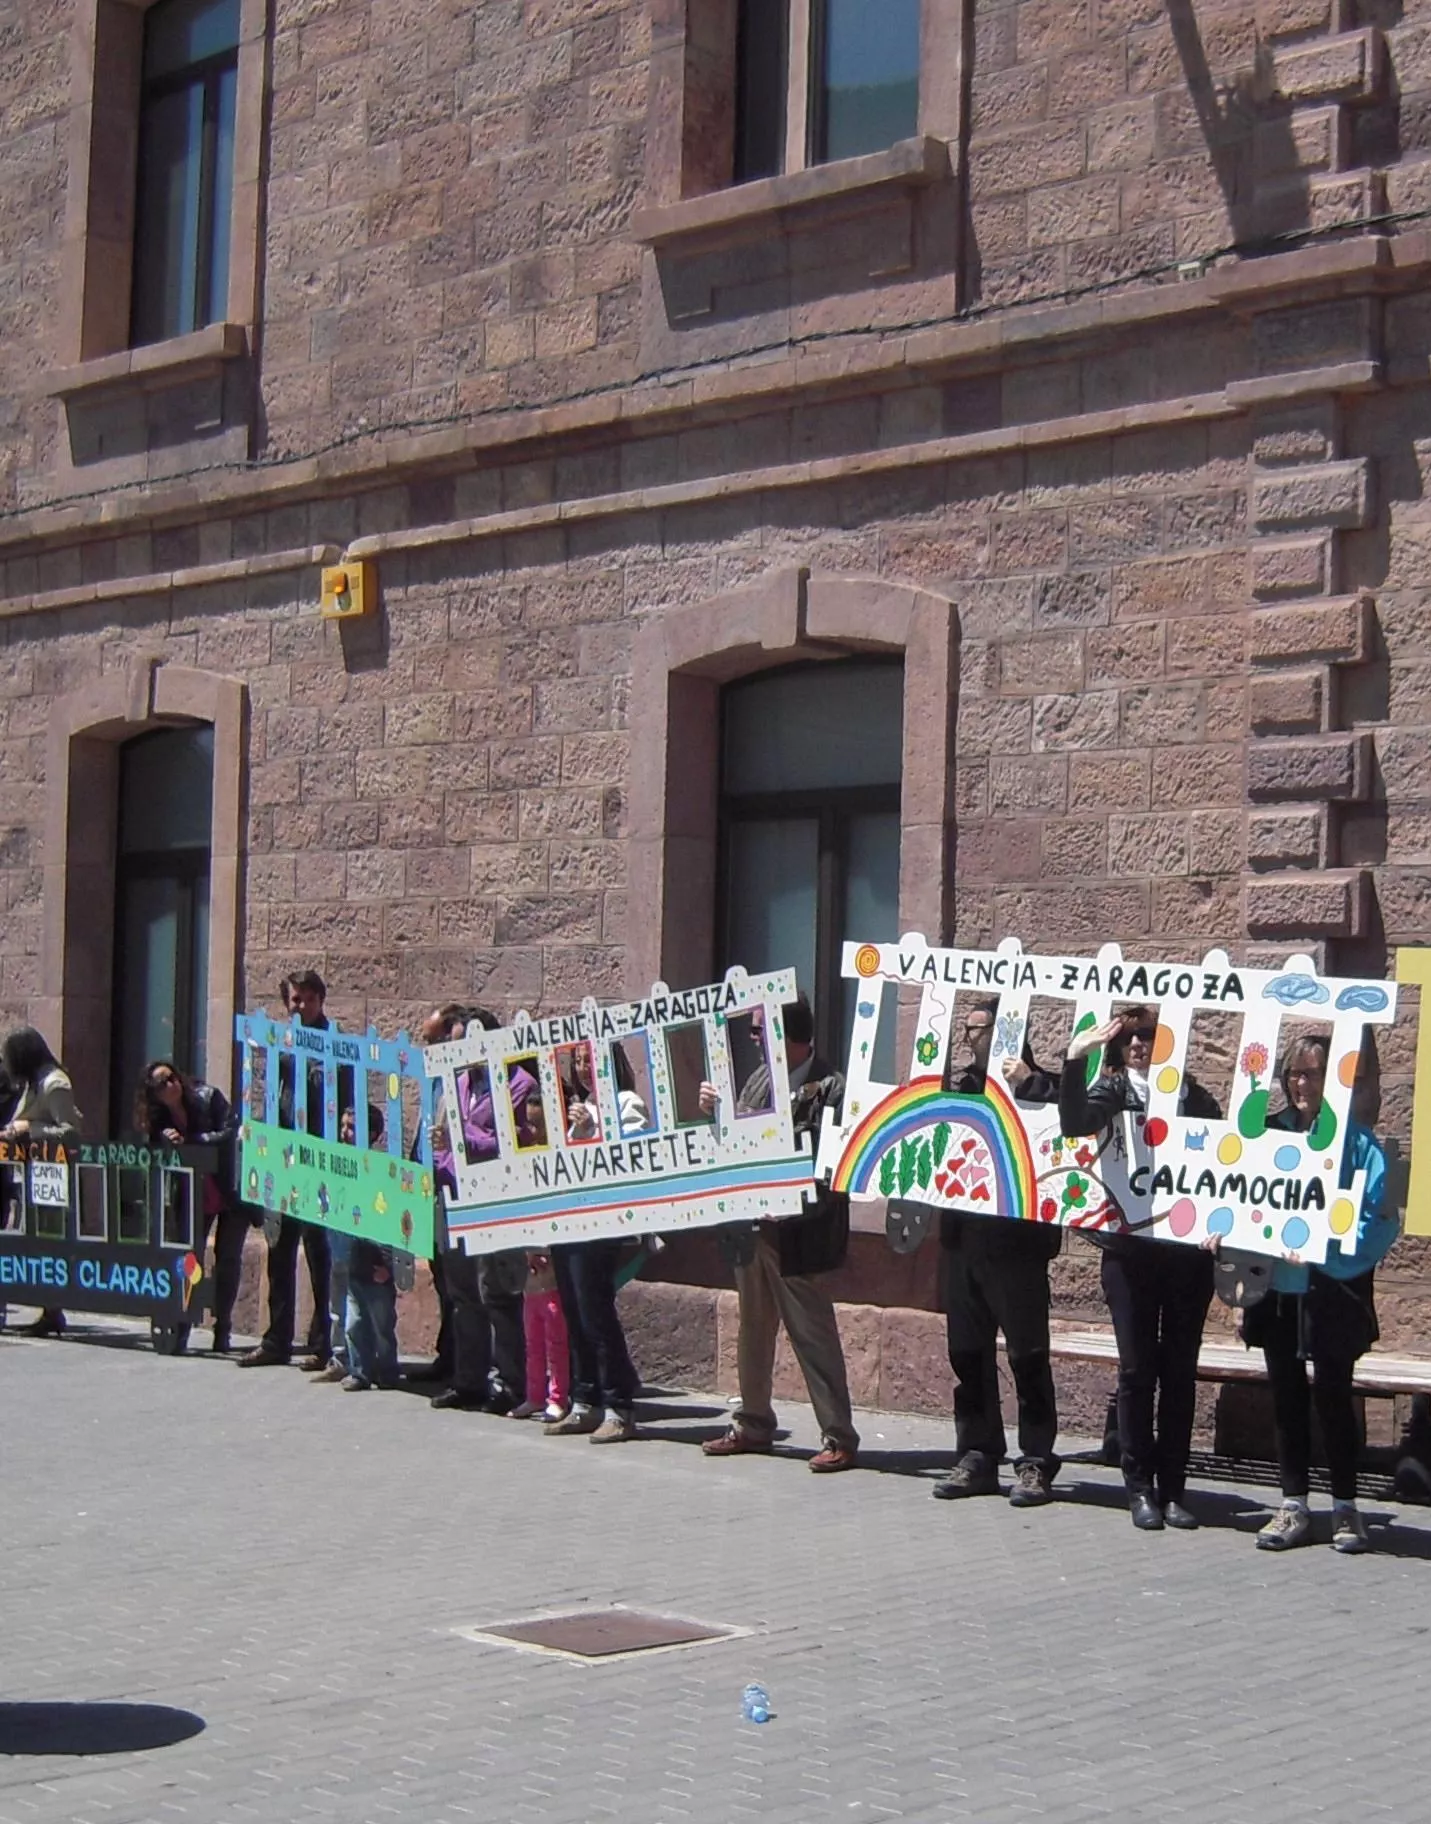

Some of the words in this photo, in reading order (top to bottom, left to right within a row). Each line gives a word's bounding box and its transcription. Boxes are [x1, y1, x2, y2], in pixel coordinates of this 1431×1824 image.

[531, 1130, 703, 1188] NAVARRETE
[33, 1184, 66, 1203] REAL
[1128, 1165, 1326, 1211] CALAMOCHA
[79, 1260, 172, 1299] CLARAS
